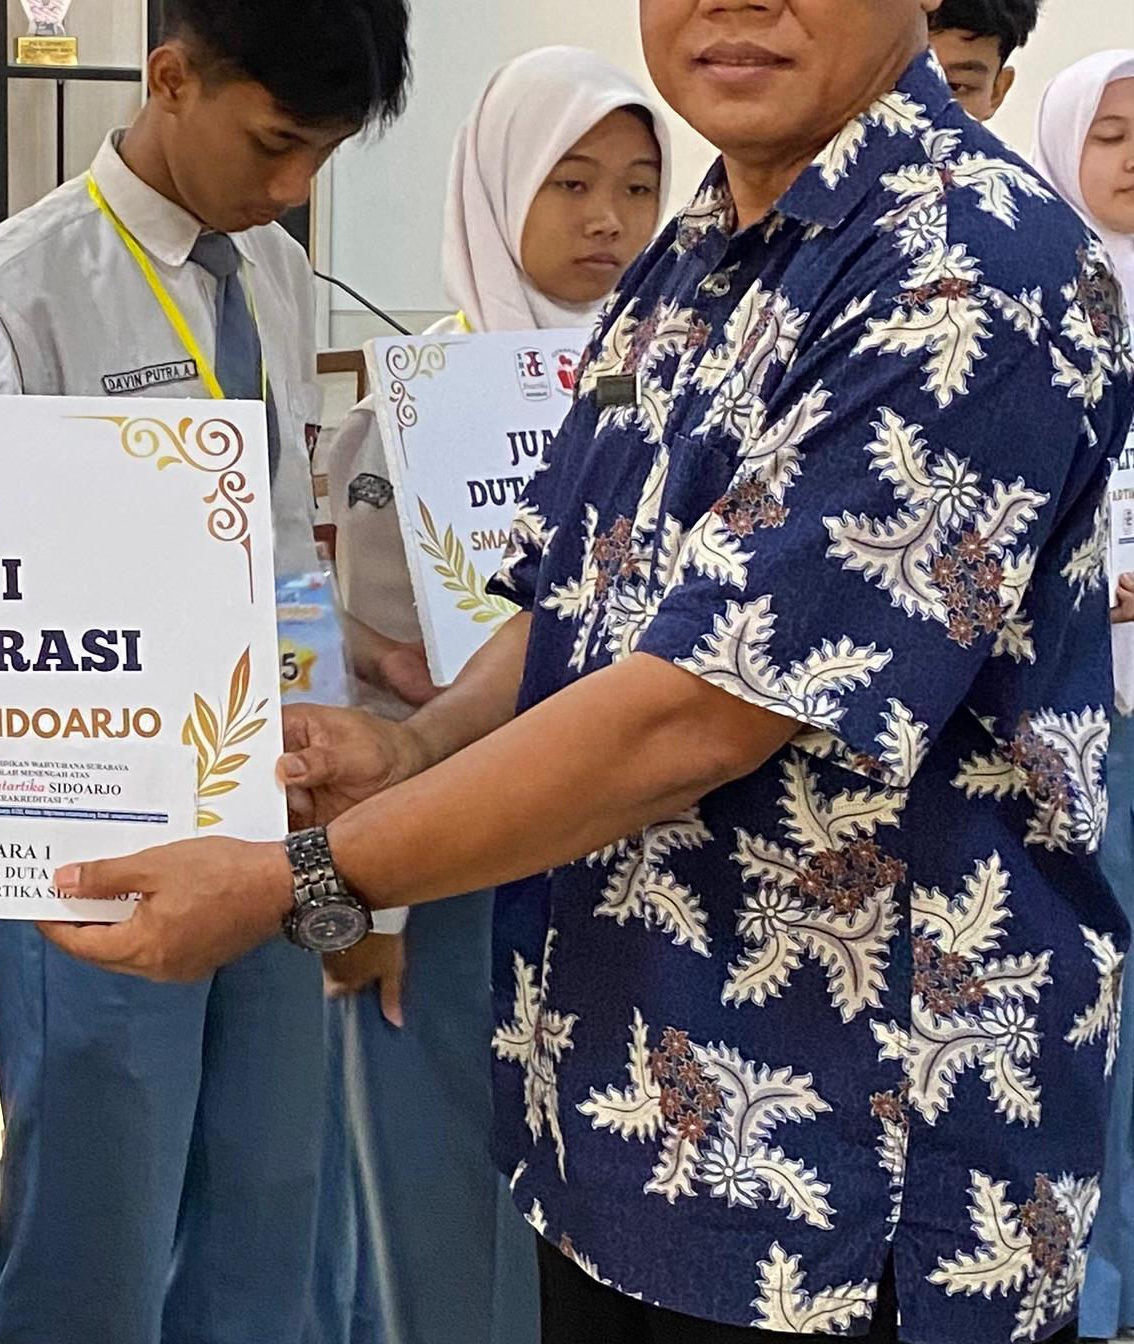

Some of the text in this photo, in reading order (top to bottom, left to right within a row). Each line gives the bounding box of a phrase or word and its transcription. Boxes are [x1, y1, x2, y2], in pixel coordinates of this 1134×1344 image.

[107, 373, 143, 391] DAVIN
[145, 364, 180, 383] PUTRA
[1, 557, 23, 601] I
[20, 770, 68, 778] MENENGAH
[49, 782, 122, 796] SIDOARJO
[5, 866, 49, 880] DUTA
